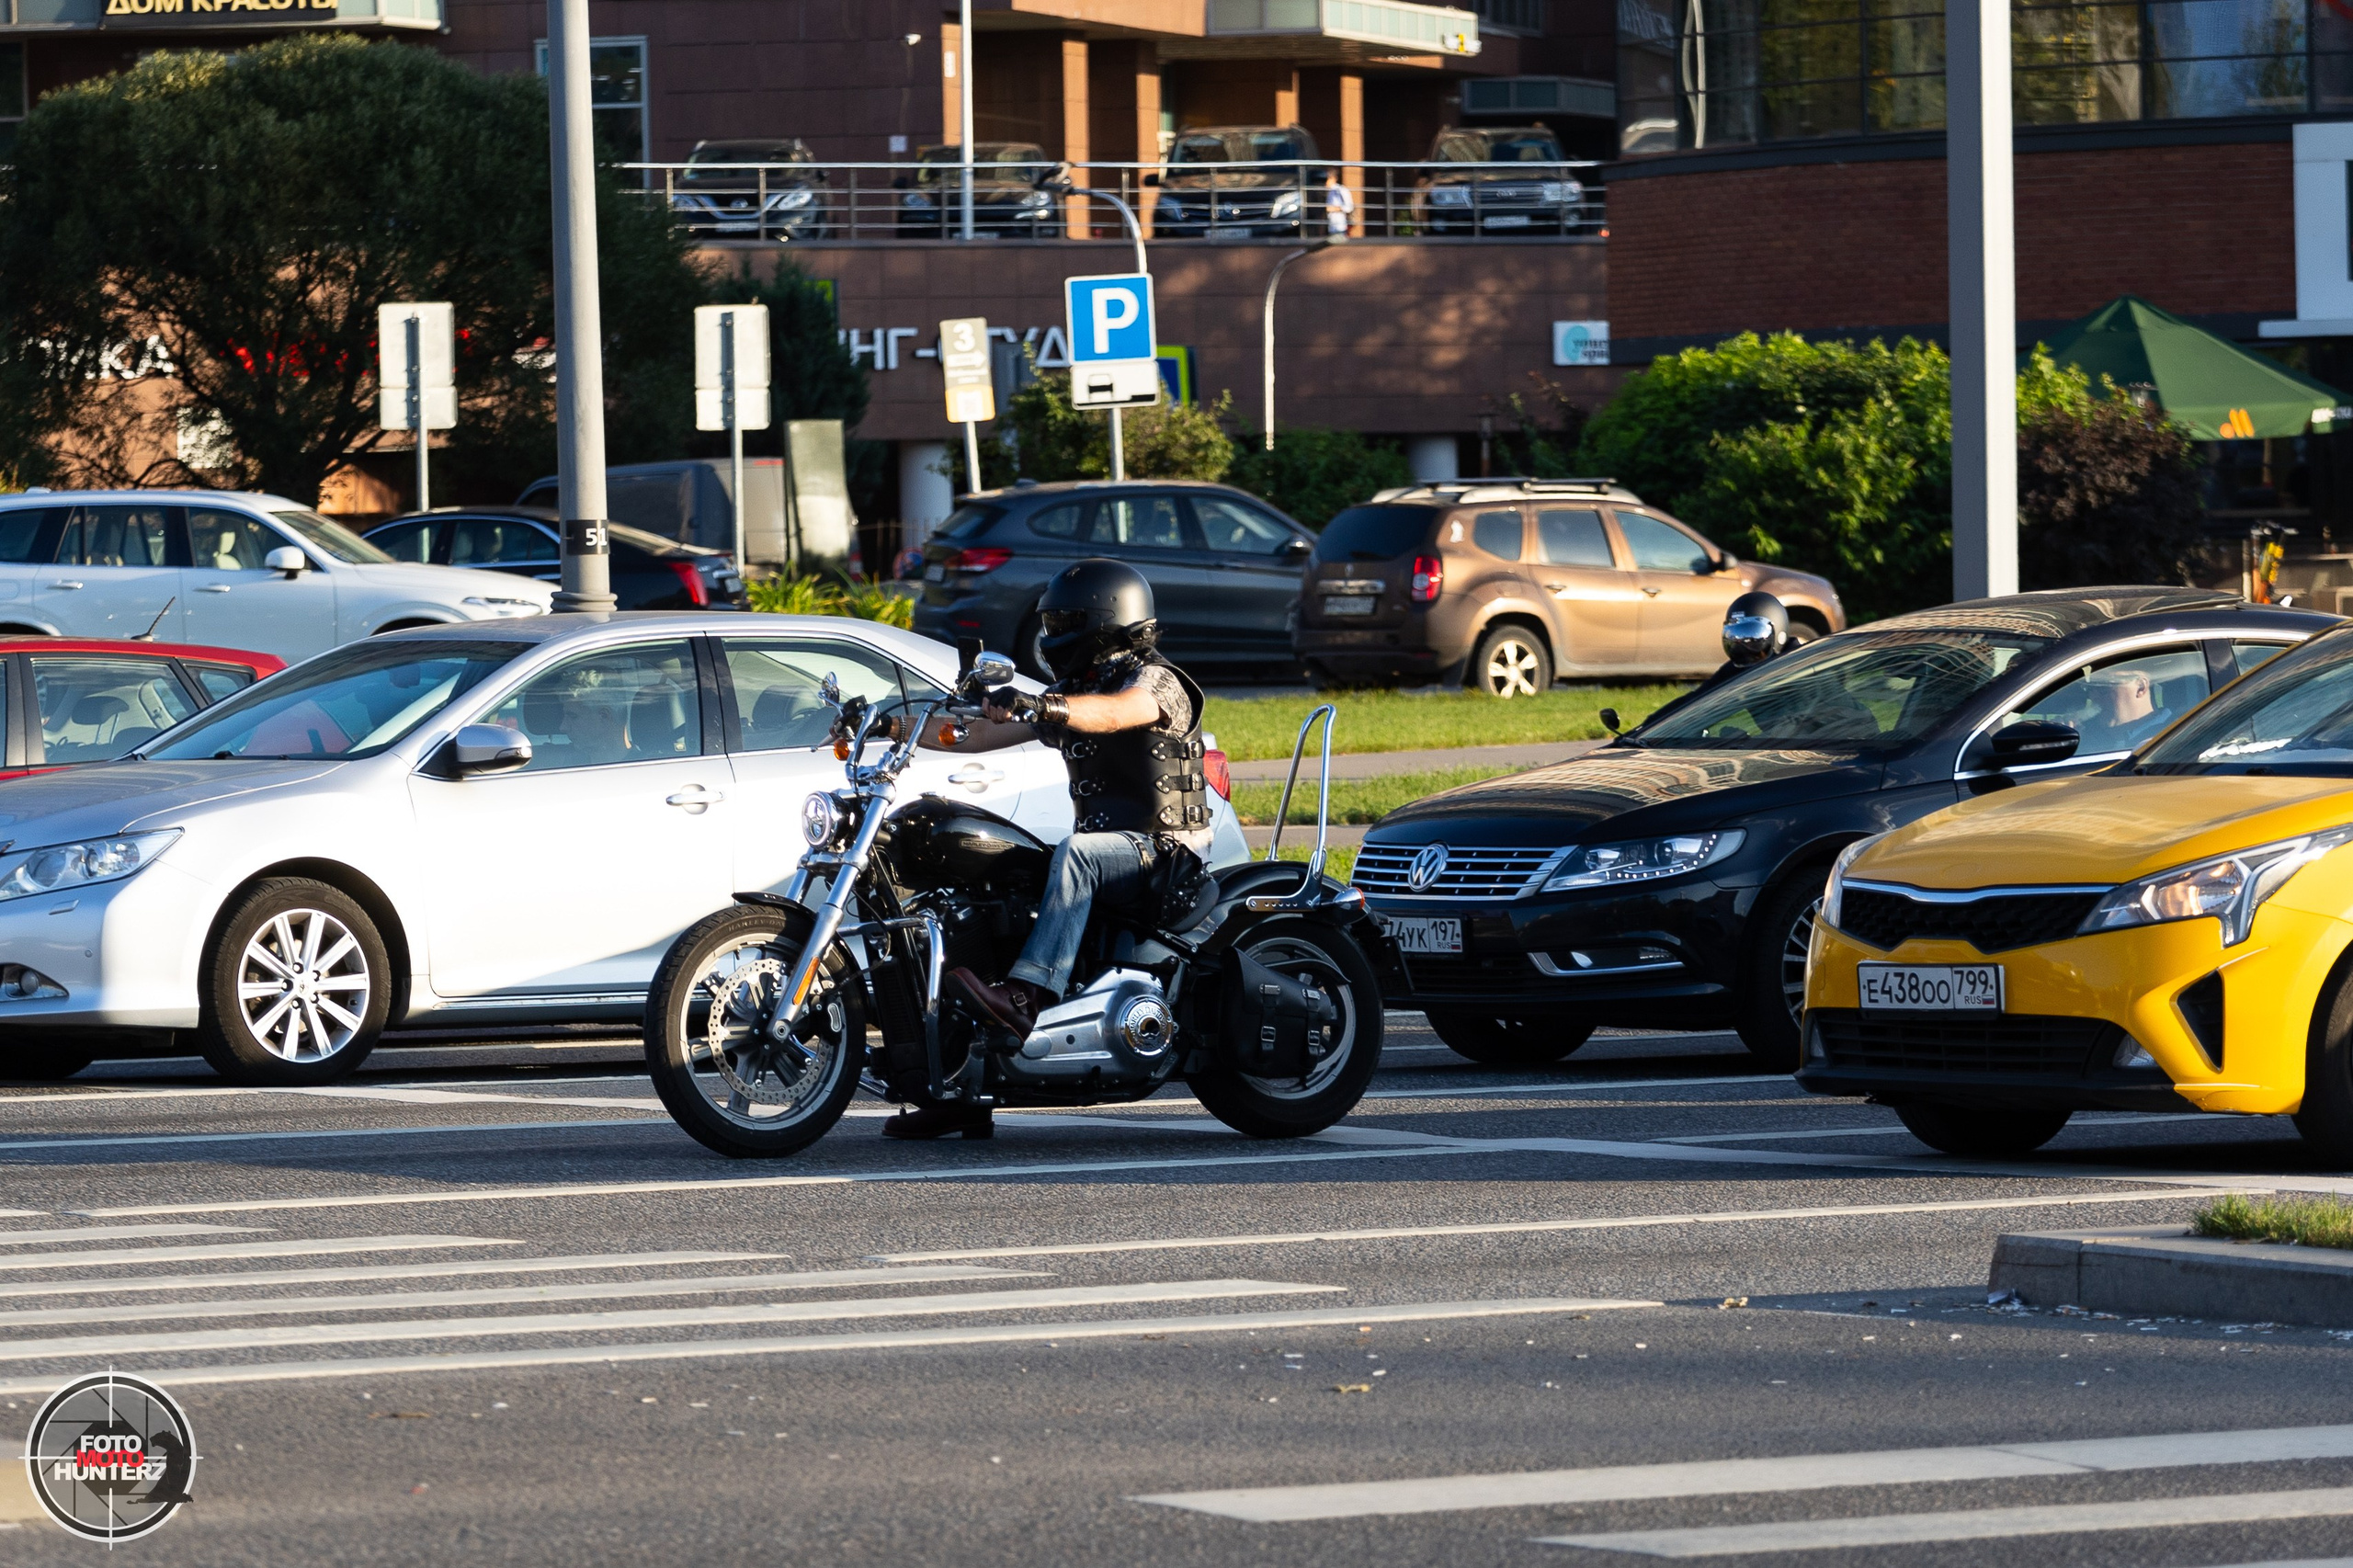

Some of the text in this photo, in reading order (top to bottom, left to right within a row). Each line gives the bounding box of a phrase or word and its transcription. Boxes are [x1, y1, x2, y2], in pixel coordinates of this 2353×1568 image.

[1091, 287, 1140, 354] P
[952, 322, 975, 352] 3
[585, 528, 608, 546] 51
[1431, 920, 1456, 940] 197
[1954, 970, 1989, 994] 799
[1964, 995, 1982, 1005] RUS
